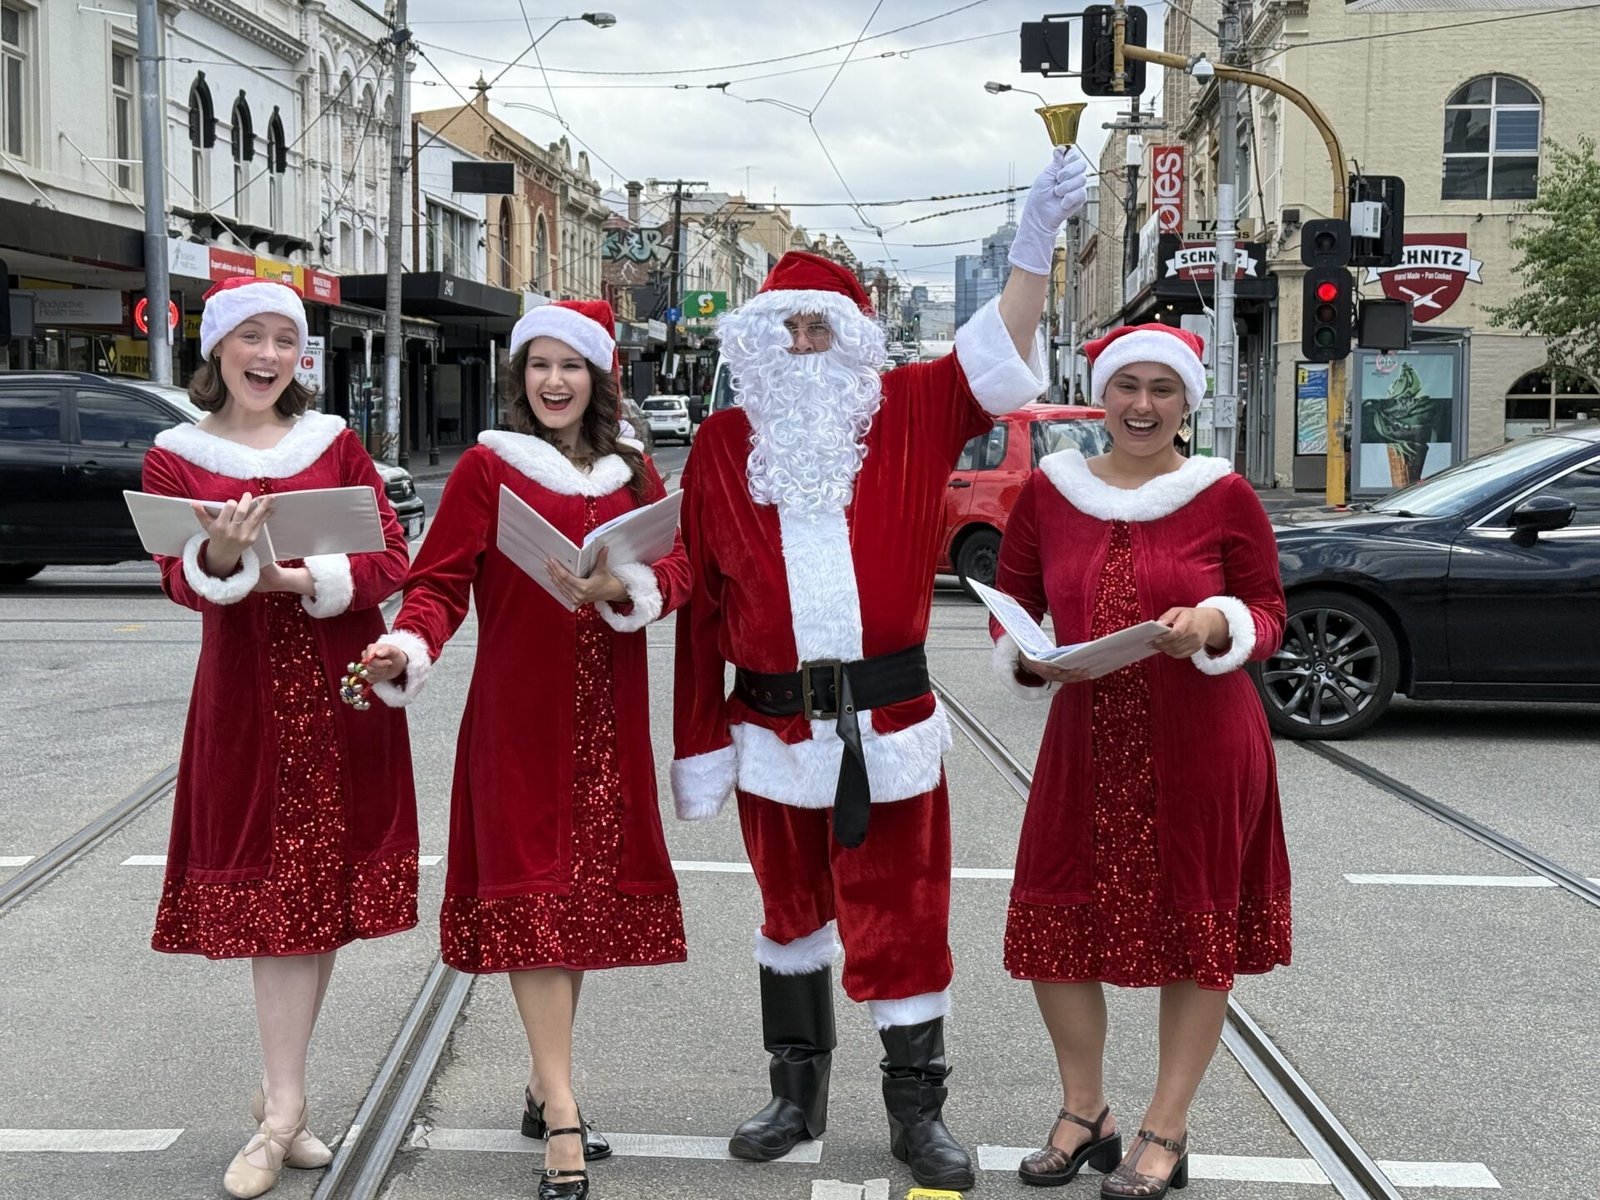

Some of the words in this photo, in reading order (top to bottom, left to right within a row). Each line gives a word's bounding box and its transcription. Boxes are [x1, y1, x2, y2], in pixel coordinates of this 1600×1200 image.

[1154, 152, 1181, 233] oles
[1187, 231, 1250, 240] RETNS
[1181, 250, 1242, 264] SCHN
[1399, 250, 1464, 266] HNITZ
[1407, 272, 1420, 280] Made
